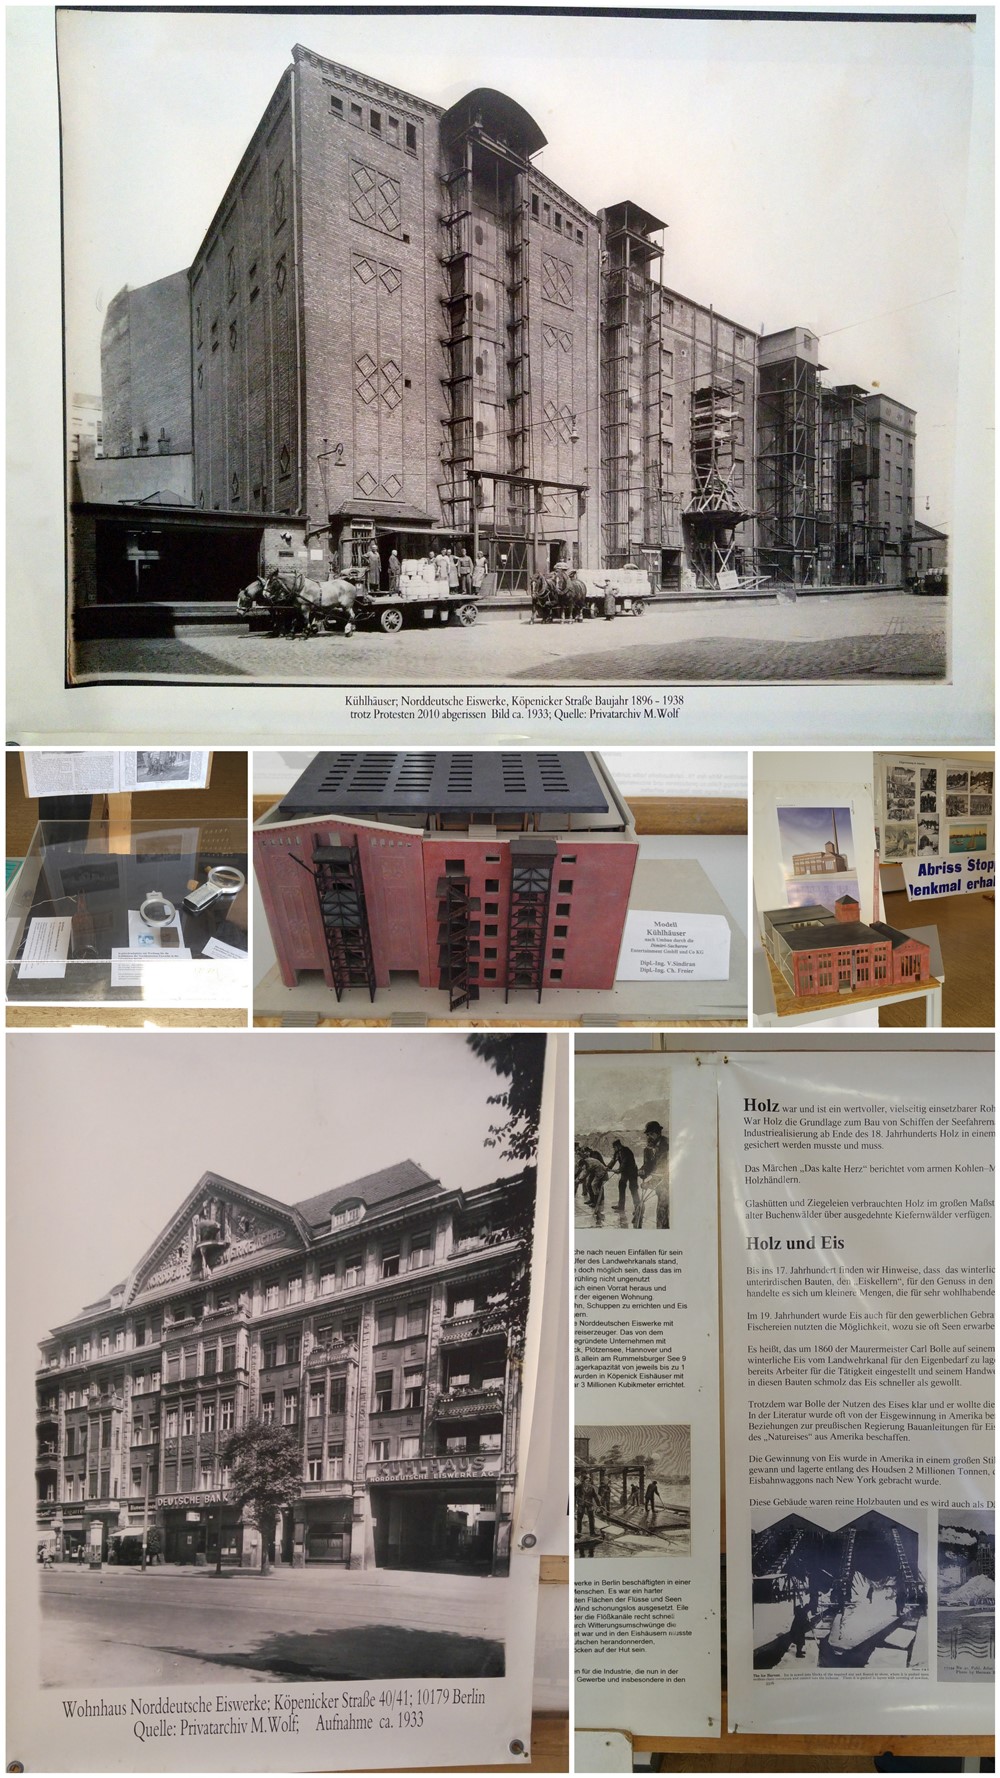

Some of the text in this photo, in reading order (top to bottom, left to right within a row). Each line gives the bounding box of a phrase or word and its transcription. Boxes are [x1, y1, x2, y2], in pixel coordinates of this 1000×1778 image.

[345, 696, 399, 708] Kühlhäuser;
[401, 696, 464, 706] Norddeutsche
[466, 695, 509, 707] Eiswerke,
[512, 695, 563, 707] Köpenicker
[565, 695, 593, 705] Straße
[595, 695, 629, 707] Baujahr
[632, 695, 654, 705] 1896
[663, 695, 685, 705] 1938
[350, 709, 372, 719] trotz
[374, 709, 415, 719] Protesten
[417, 709, 441, 719] 2010
[442, 709, 487, 721] abgerissen
[491, 709, 510, 719] Bild
[528, 709, 552, 721] 1933;
[554, 709, 587, 719] Quelle:
[589, 709, 642, 719] Privatarchiv
[643, 709, 679, 719] M.Wolf
[918, 861, 962, 876] Abriss
[646, 928, 686, 937] Kühlhäuser
[744, 1097, 780, 1112] Holz
[799, 1104, 815, 1113] und
[817, 1104, 827, 1113] ist
[828, 1104, 842, 1113] ein
[843, 1104, 888, 1114] wertvoller,
[889, 1104, 927, 1114] vielseitig
[928, 1104, 978, 1113] einsetzbarer
[980, 1104, 995, 1113] Roh
[743, 1117, 762, 1125] War
[763, 1117, 783, 1125] Holz
[784, 1117, 798, 1126] die
[799, 1117, 842, 1127] Grundlage
[864, 1117, 881, 1126] Bau
[900, 1117, 934, 1126] Schiffen
[936, 1117, 950, 1126] der
[744, 1129, 819, 1139] Industriealisierung
[820, 1129, 830, 1138] ab
[833, 1129, 853, 1138] Ende
[855, 1129, 869, 1138] des
[872, 1129, 883, 1138] 18.
[886, 1129, 937, 1138] Jahrhunderts
[940, 1129, 959, 1138] Holz
[962, 1129, 970, 1138] in
[744, 1140, 780, 1151] gesichert
[782, 1141, 812, 1149] werden
[814, 1141, 842, 1149] musste
[844, 1141, 859, 1150] und
[746, 1236, 845, 1250] Holz und Eis
[658, 1258, 680, 1266] stand,
[587, 1302, 621, 1310] Schuppen
[748, 1345, 758, 1353] Es
[759, 1345, 782, 1355] heißt,
[783, 1345, 797, 1353] das
[815, 1345, 834, 1353] 1860
[835, 1345, 848, 1353] der
[850, 1345, 909, 1353] Maurermeister
[910, 1345, 927, 1353] Carl
[930, 1345, 951, 1353] Bolle
[952, 1345, 967, 1353] auf
[967, 1345, 995, 1353] seinem
[748, 1378, 962, 1389] in diesen Bauten schmolz das Eis schneller als gewollt.
[370, 1474, 429, 1483] NORDDEUTSCHE
[433, 1471, 478, 1479] EISWERKE
[749, 1476, 942, 1487] Eisbahnwaggons nach New York gebracht wurde.
[158, 1492, 229, 1507] DEUTSCHE BANK
[622, 1579, 666, 1587] beschäftigten
[62, 1688, 486, 1718] Wohnhaus Norddeutsche Eiswerke; Köpenicker Straße 40/41; 10179 Berlin
[134, 1713, 424, 1740] Quelle: Privatarchiv M.Wolf; Aufnahme ca. 1933
